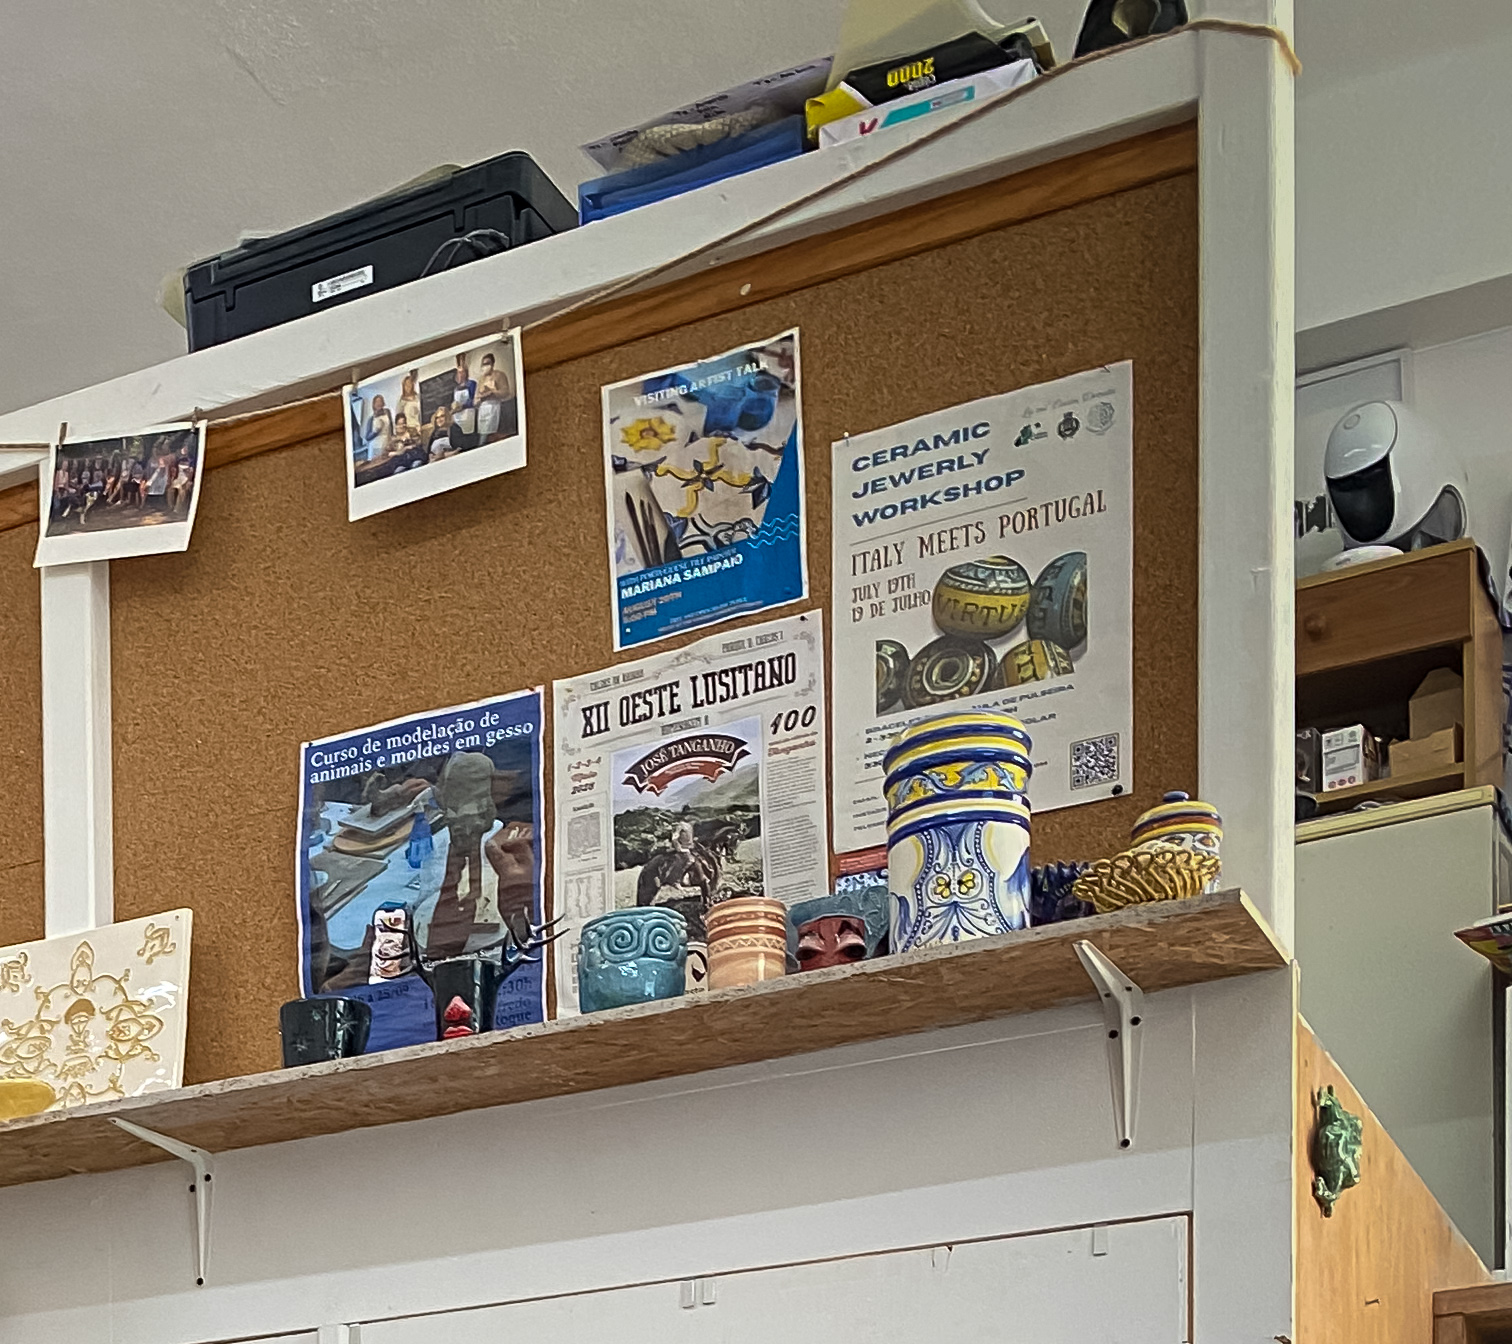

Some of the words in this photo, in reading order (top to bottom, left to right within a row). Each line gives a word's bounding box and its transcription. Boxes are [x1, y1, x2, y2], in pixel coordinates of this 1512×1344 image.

[633, 384, 687, 407] VISITING
[689, 369, 733, 393] ARTIST
[736, 361, 769, 378] TALK
[851, 421, 991, 473] CERAMIC
[851, 448, 990, 499] JEWERLY
[851, 469, 1026, 528] WORKSHOP
[851, 540, 906, 577] ITALY
[917, 521, 986, 559] MEETS
[998, 489, 1107, 539] PORTUGAL
[621, 573, 682, 600] MARIANA
[683, 553, 744, 582] SAMPAIO
[851, 581, 881, 604] JULY
[888, 572, 916, 595] 19TH
[851, 606, 864, 623] 19
[870, 600, 886, 619] DE
[892, 589, 932, 614] JULHO
[581, 700, 611, 739] XII
[619, 679, 682, 728] OESTE
[690, 651, 797, 710] LUSITANO
[309, 757, 373, 784] animais
[376, 755, 386, 768] e
[390, 740, 450, 765] moldes
[455, 733, 481, 750] em
[485, 721, 534, 747] gesso
[310, 746, 358, 769] Curso
[362, 738, 381, 756] de
[387, 717, 475, 750] modelação
[479, 711, 500, 728] de
[668, 738, 736, 759] TANGANHO
